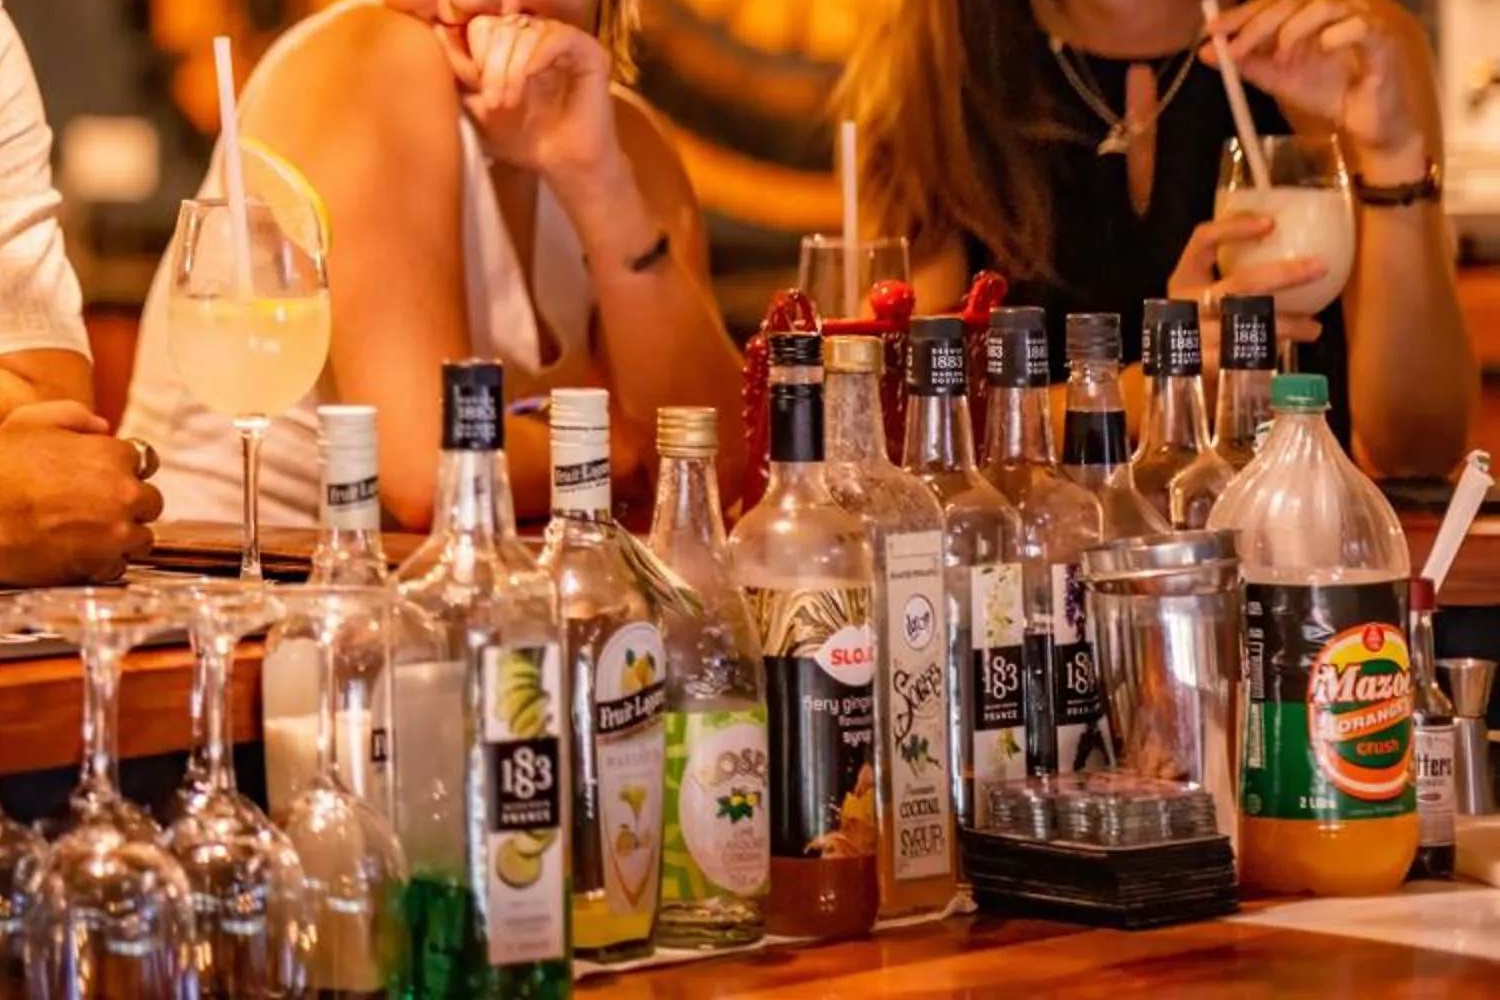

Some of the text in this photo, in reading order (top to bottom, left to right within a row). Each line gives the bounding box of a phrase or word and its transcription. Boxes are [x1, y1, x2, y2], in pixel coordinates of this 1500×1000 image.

[931, 356, 963, 369] 1883
[1356, 738, 1399, 757] crush
[1417, 752, 1452, 777] tters
[900, 824, 943, 857] SYRUP
